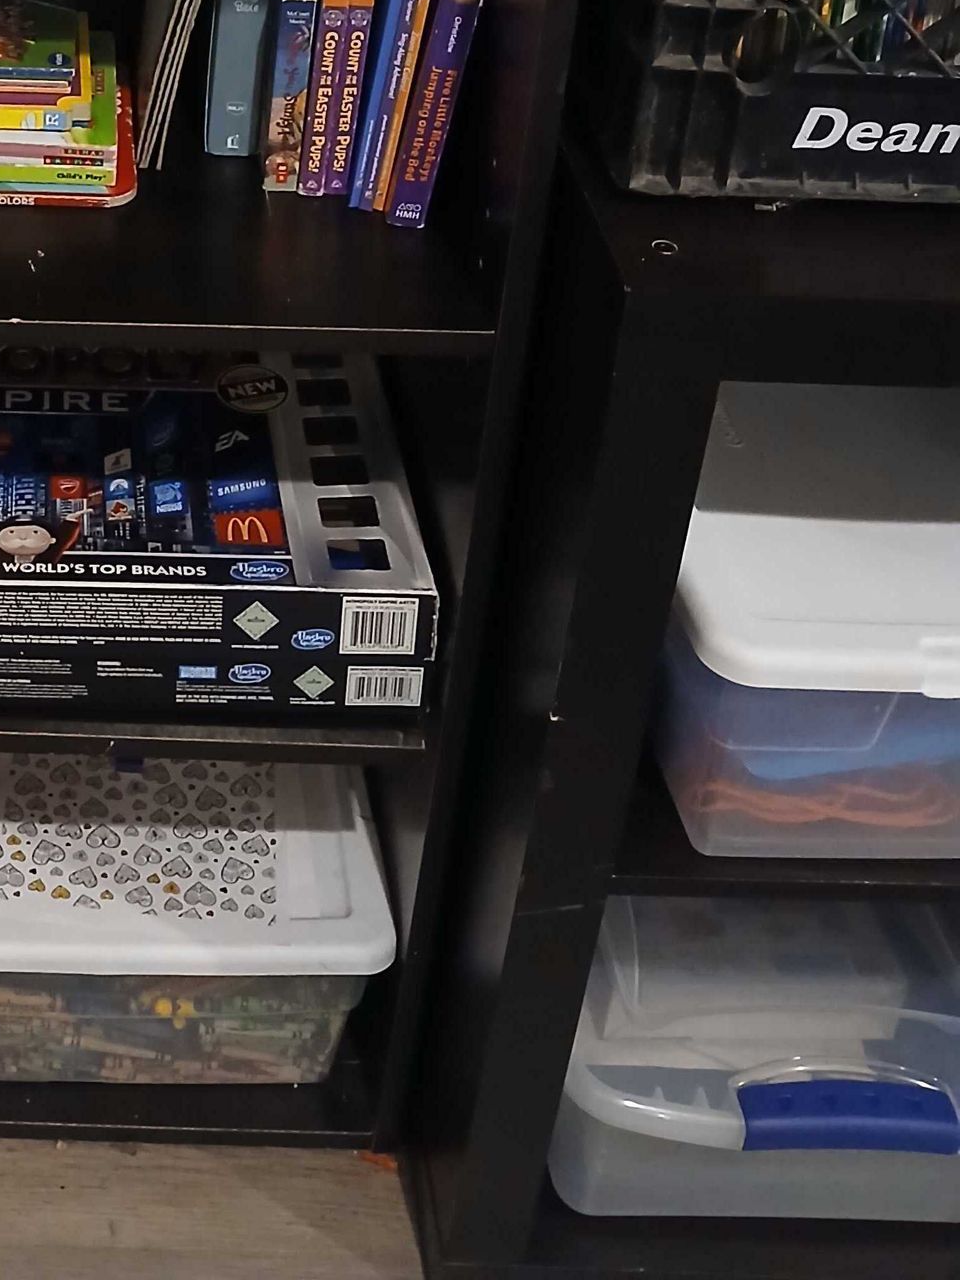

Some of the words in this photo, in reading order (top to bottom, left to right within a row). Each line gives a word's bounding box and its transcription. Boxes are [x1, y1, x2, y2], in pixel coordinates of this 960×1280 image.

[321, 31, 339, 74] COUNT
[346, 30, 365, 73] COUNT
[416, 66, 443, 118] Jumping
[445, 70, 458, 95] Five
[312, 86, 332, 132] EASTER
[339, 86, 358, 132] EASTER
[436, 96, 450, 127] Little
[416, 119, 428, 134] on
[792, 107, 960, 153] Dean
[308, 135, 326, 173] PUPS!
[333, 135, 351, 172] PUPS!
[411, 136, 424, 156] the
[419, 129, 442, 182] Monkeys
[404, 158, 417, 182] Bed
[396, 209, 420, 220] HMH
[228, 378, 276, 399] NEW
[215, 430, 249, 452] EA
[218, 478, 266, 496] SAMSUNG
[2, 562, 85, 575] WORLD'S
[91, 564, 128, 575] TOP
[131, 565, 207, 577] BRANDS
